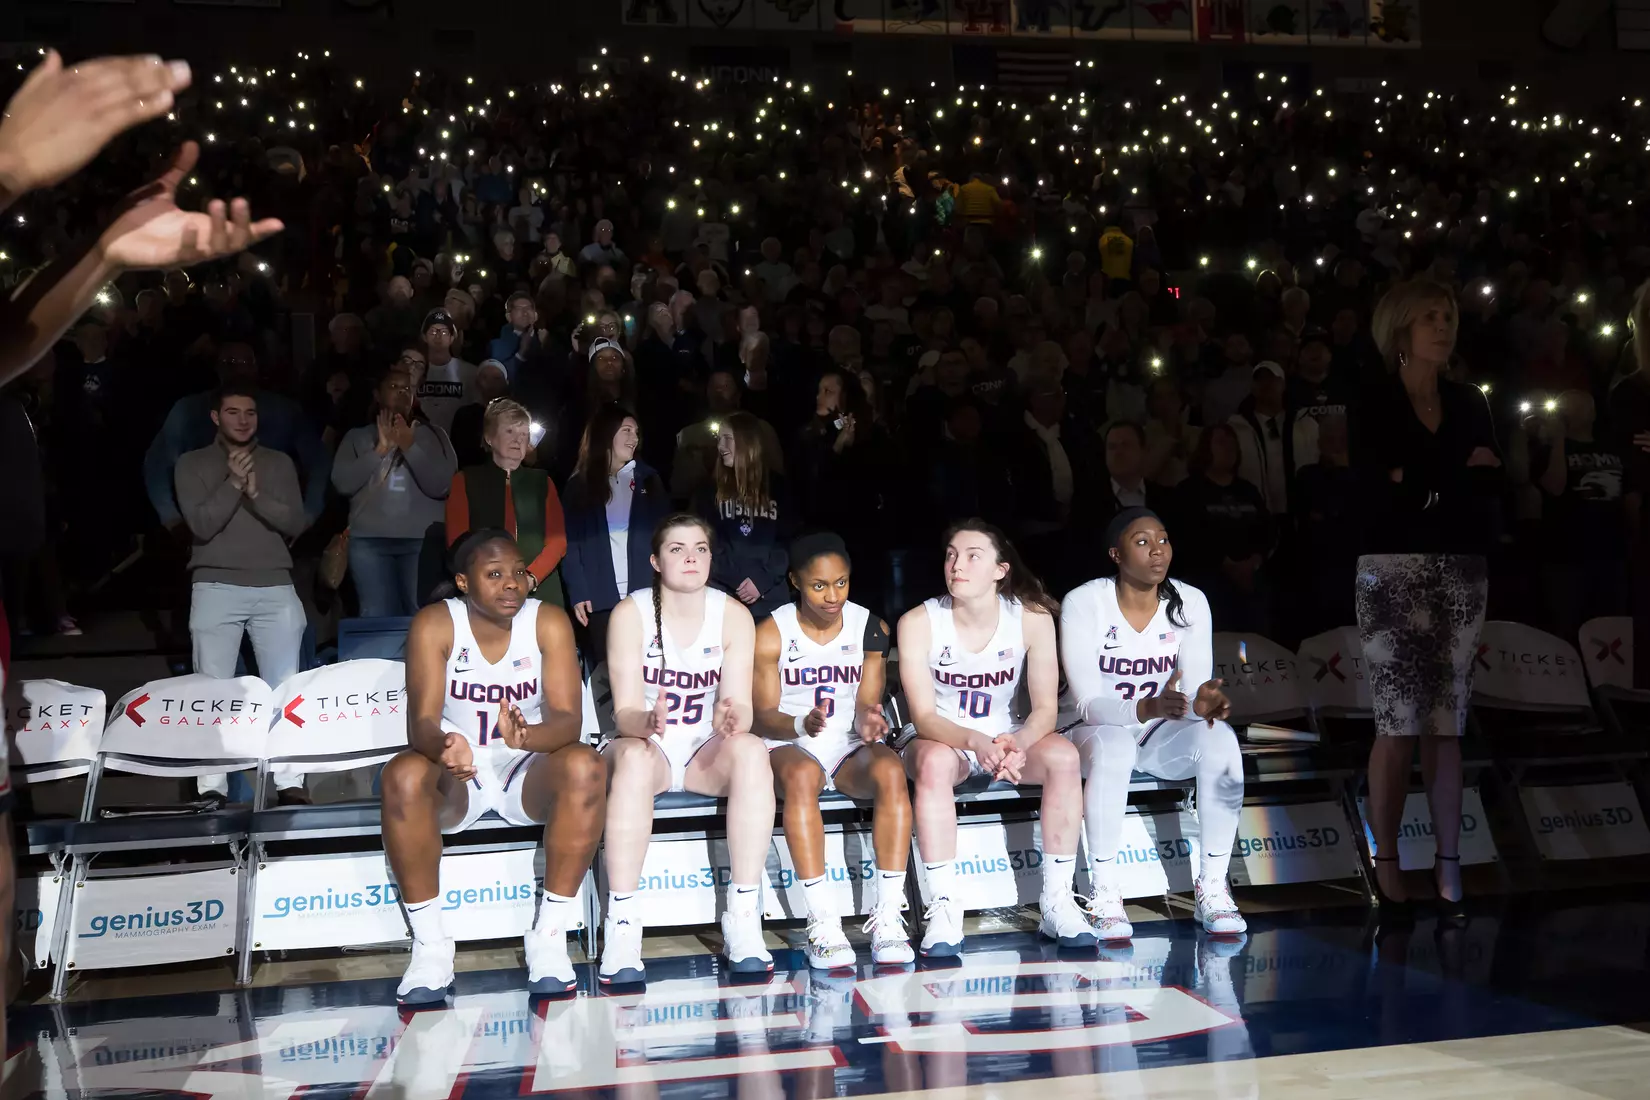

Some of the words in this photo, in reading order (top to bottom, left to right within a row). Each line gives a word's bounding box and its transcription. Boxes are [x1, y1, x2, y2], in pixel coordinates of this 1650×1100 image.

[417, 383, 462, 397] UCONN
[971, 378, 1007, 395] CONN
[783, 665, 863, 686] UCONN
[1098, 653, 1179, 676] UCONN
[642, 665, 722, 689] UCONN
[934, 666, 1015, 689] UCONN
[1222, 673, 1290, 687] GALAX
[317, 690, 399, 709] TICKE
[450, 678, 538, 704] UCONN
[5, 704, 93, 720] ICKET
[162, 699, 262, 713] TICKET
[319, 705, 399, 722] GALAX
[665, 691, 706, 725] 25
[957, 689, 993, 719] 10
[6, 720, 89, 732] ALAXY
[160, 716, 258, 726] GALAXY
[1538, 807, 1633, 833] genius3D
[1231, 827, 1340, 857] genius3D
[955, 848, 1043, 875] nius3D
[638, 867, 732, 890] enius3D
[770, 860, 875, 889] gius3
[263, 884, 401, 918] genius3D
[78, 899, 225, 938] genius3D
[114, 926, 190, 939] MAMMOGRAPHY
[191, 922, 217, 932] EXAM
